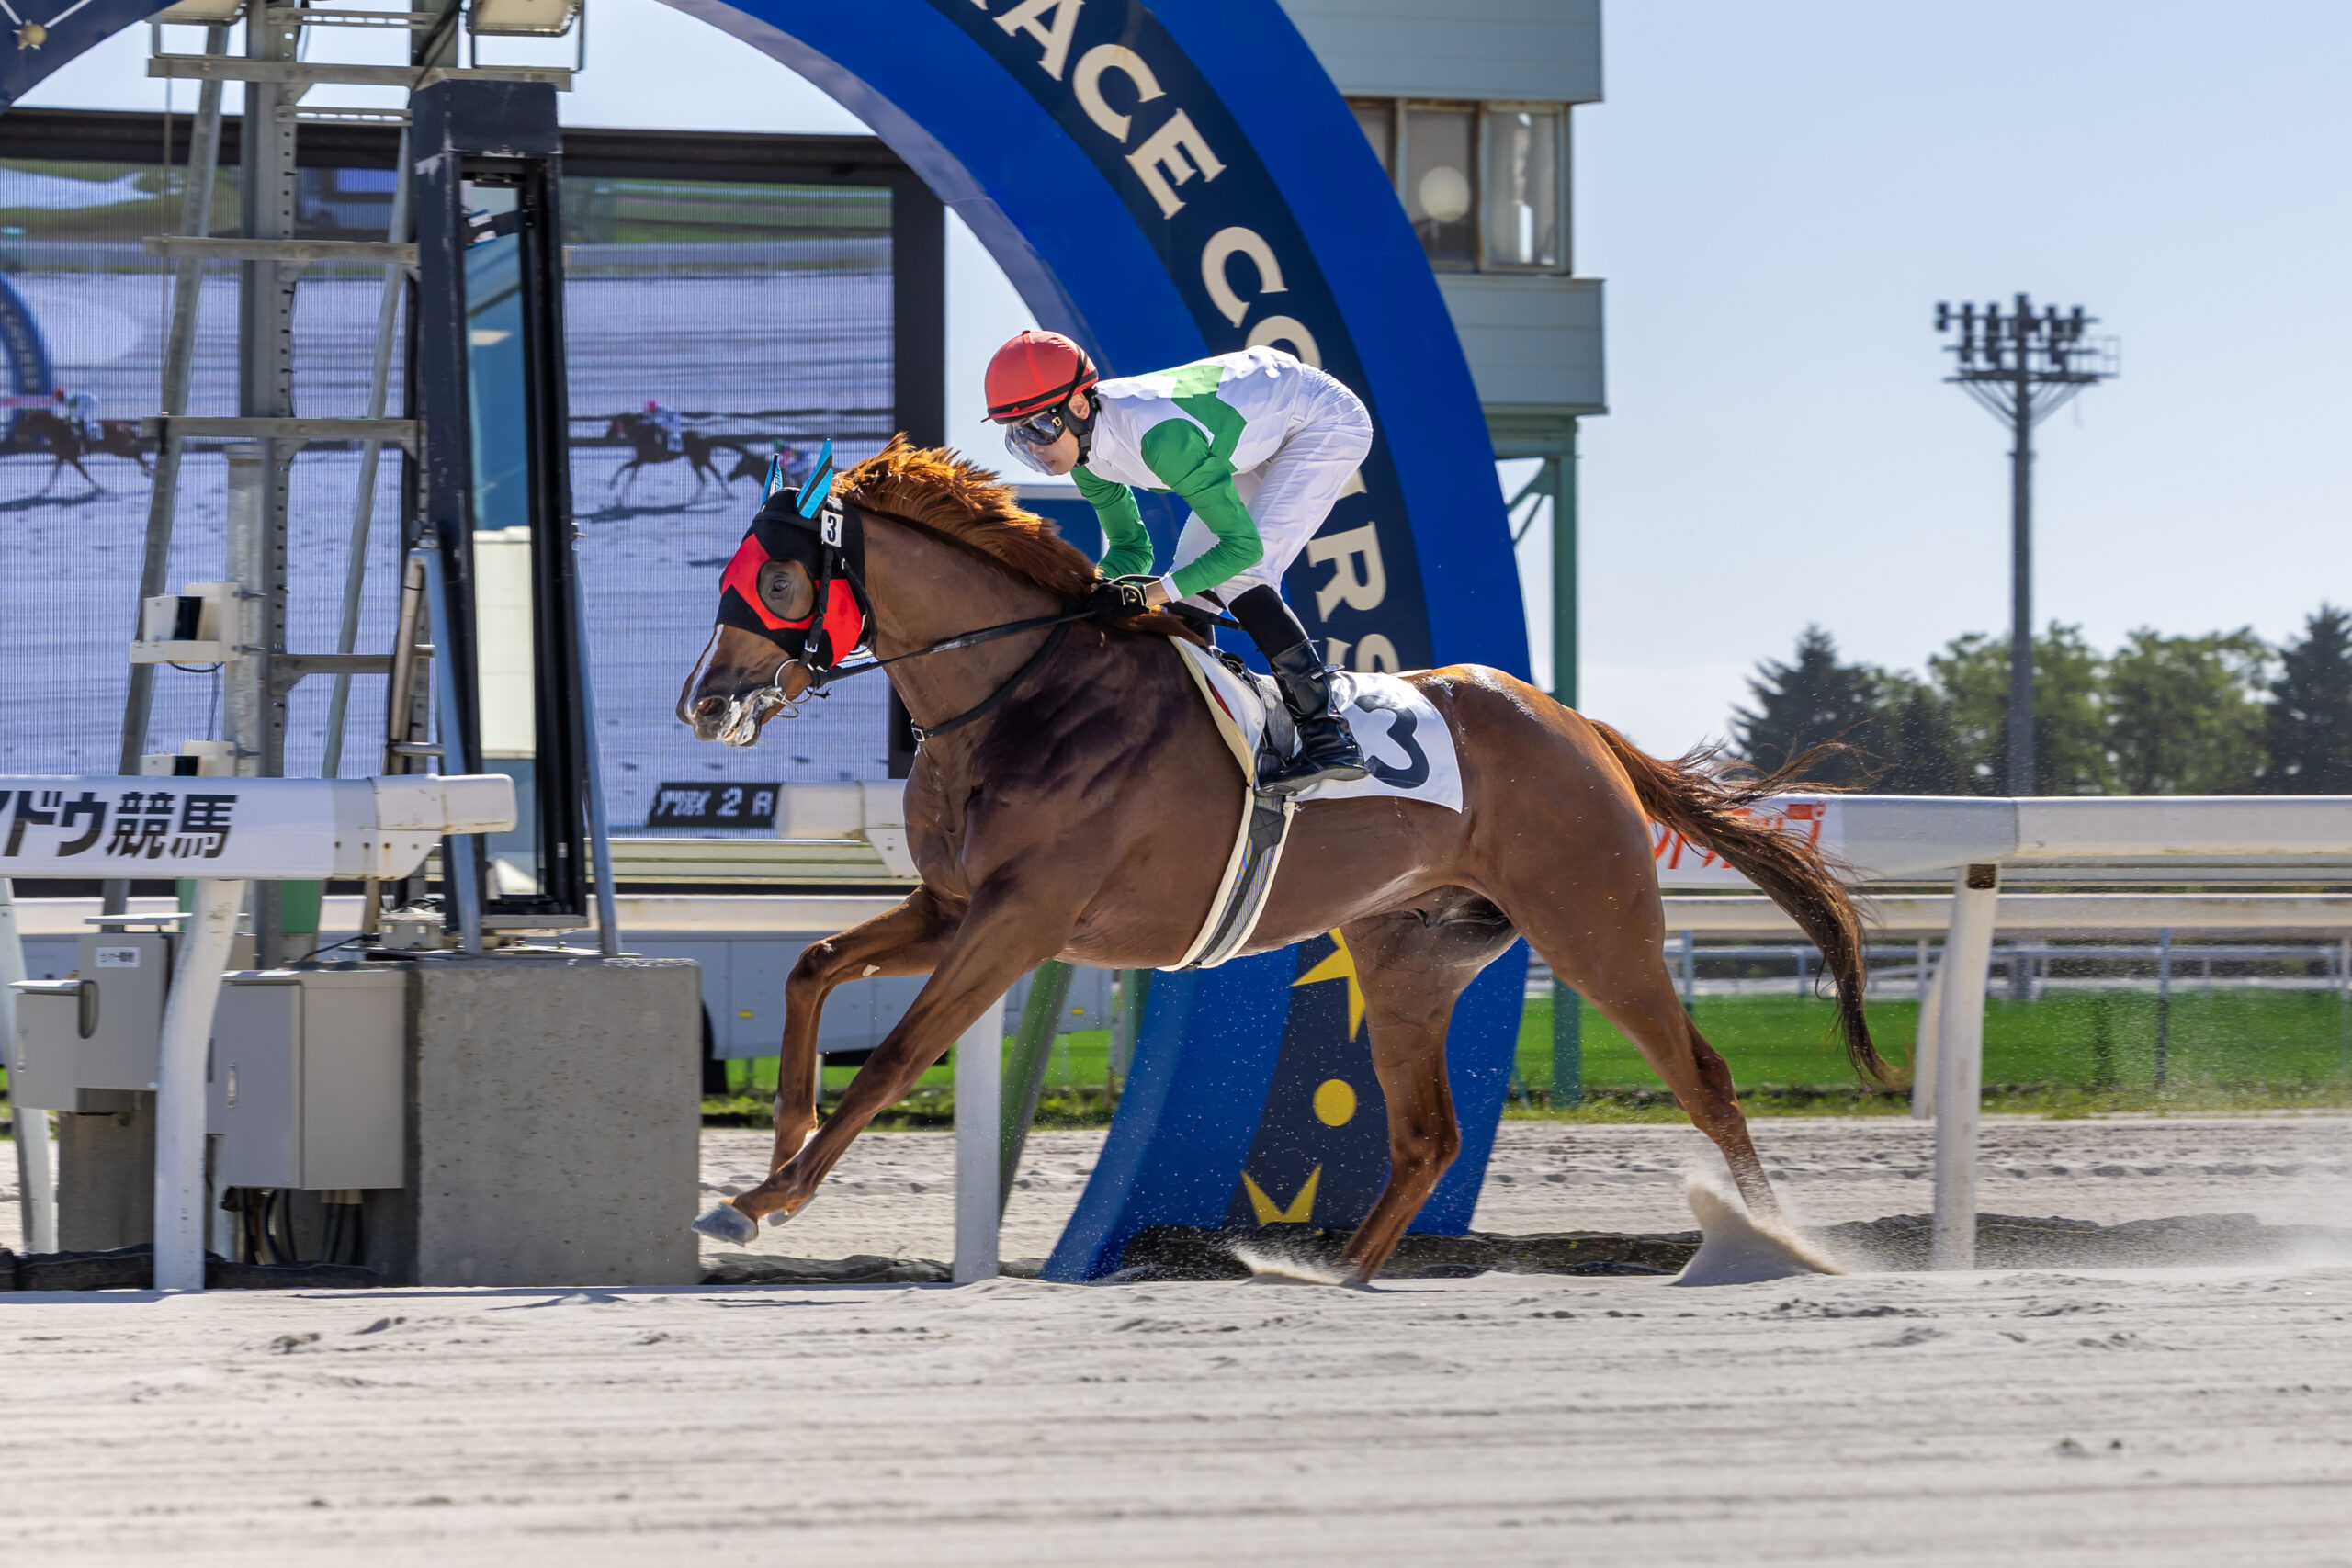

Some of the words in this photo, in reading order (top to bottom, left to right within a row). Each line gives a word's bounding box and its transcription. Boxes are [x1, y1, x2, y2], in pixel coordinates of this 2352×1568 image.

[968, 0, 1227, 220] ACE
[827, 514, 837, 543] 3
[1354, 695, 1430, 789] 3
[716, 786, 742, 817] 2
